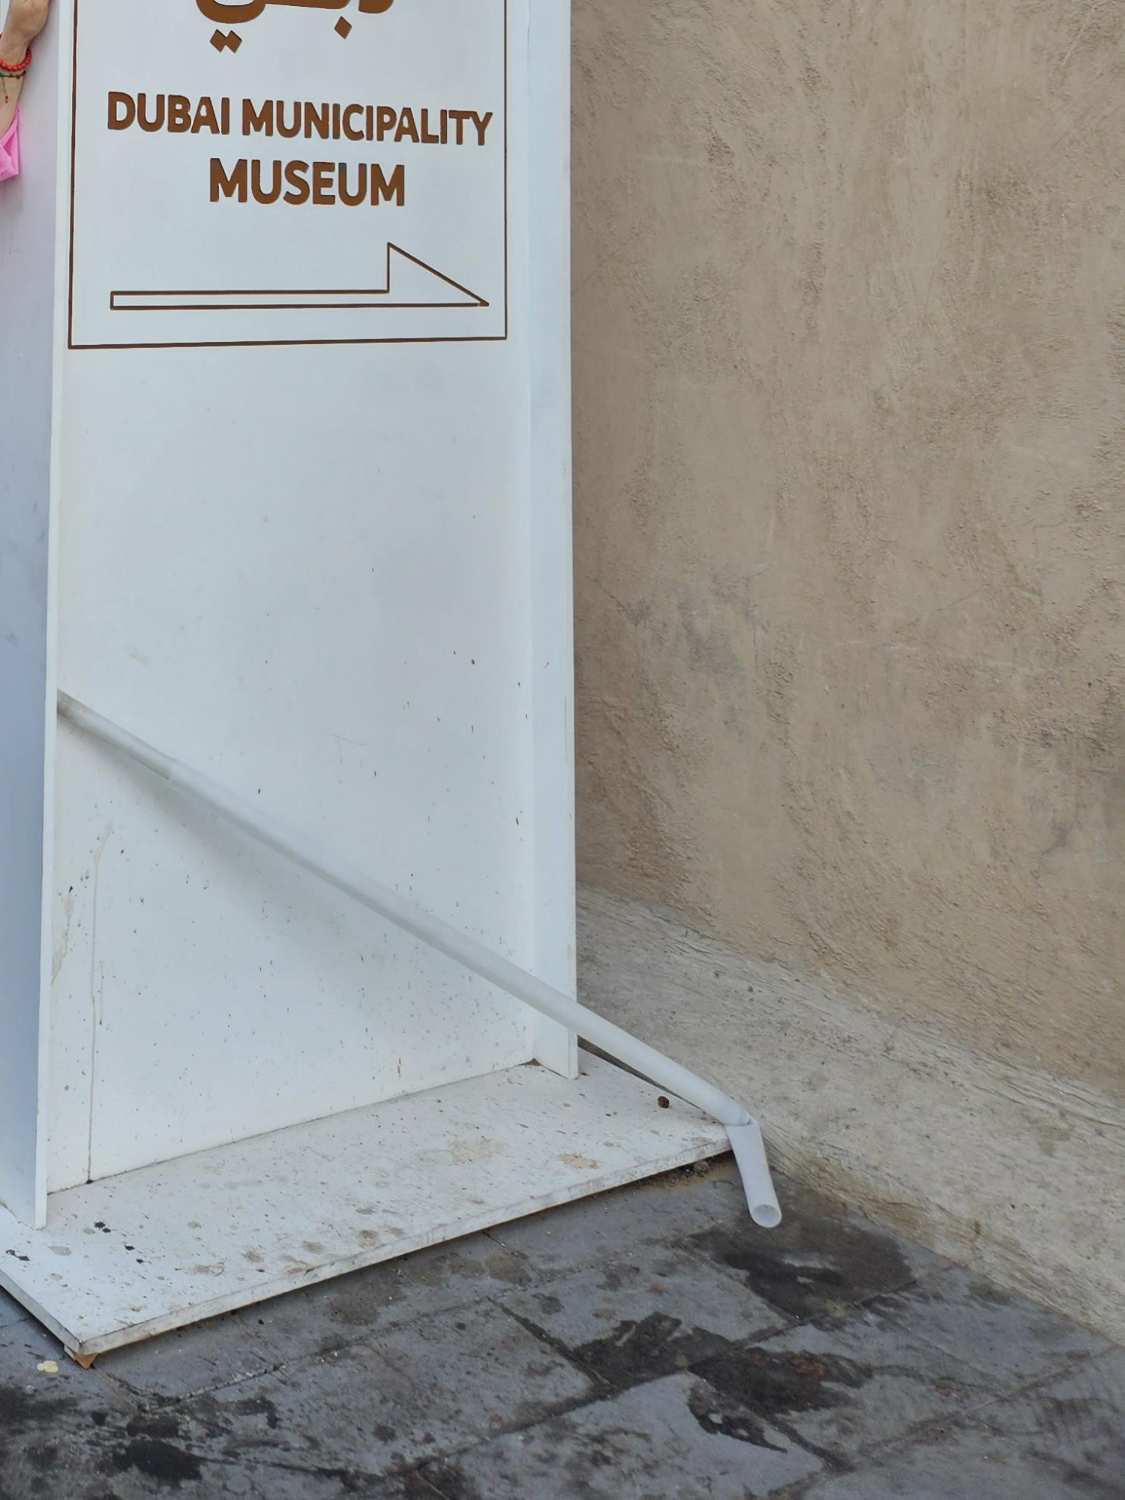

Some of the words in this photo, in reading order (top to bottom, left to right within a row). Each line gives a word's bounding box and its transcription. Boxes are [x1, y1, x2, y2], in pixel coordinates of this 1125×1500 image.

[107, 91, 230, 135] DUBAI
[241, 98, 493, 146] MUNICIPALITY
[209, 157, 406, 207] MUSEUM
